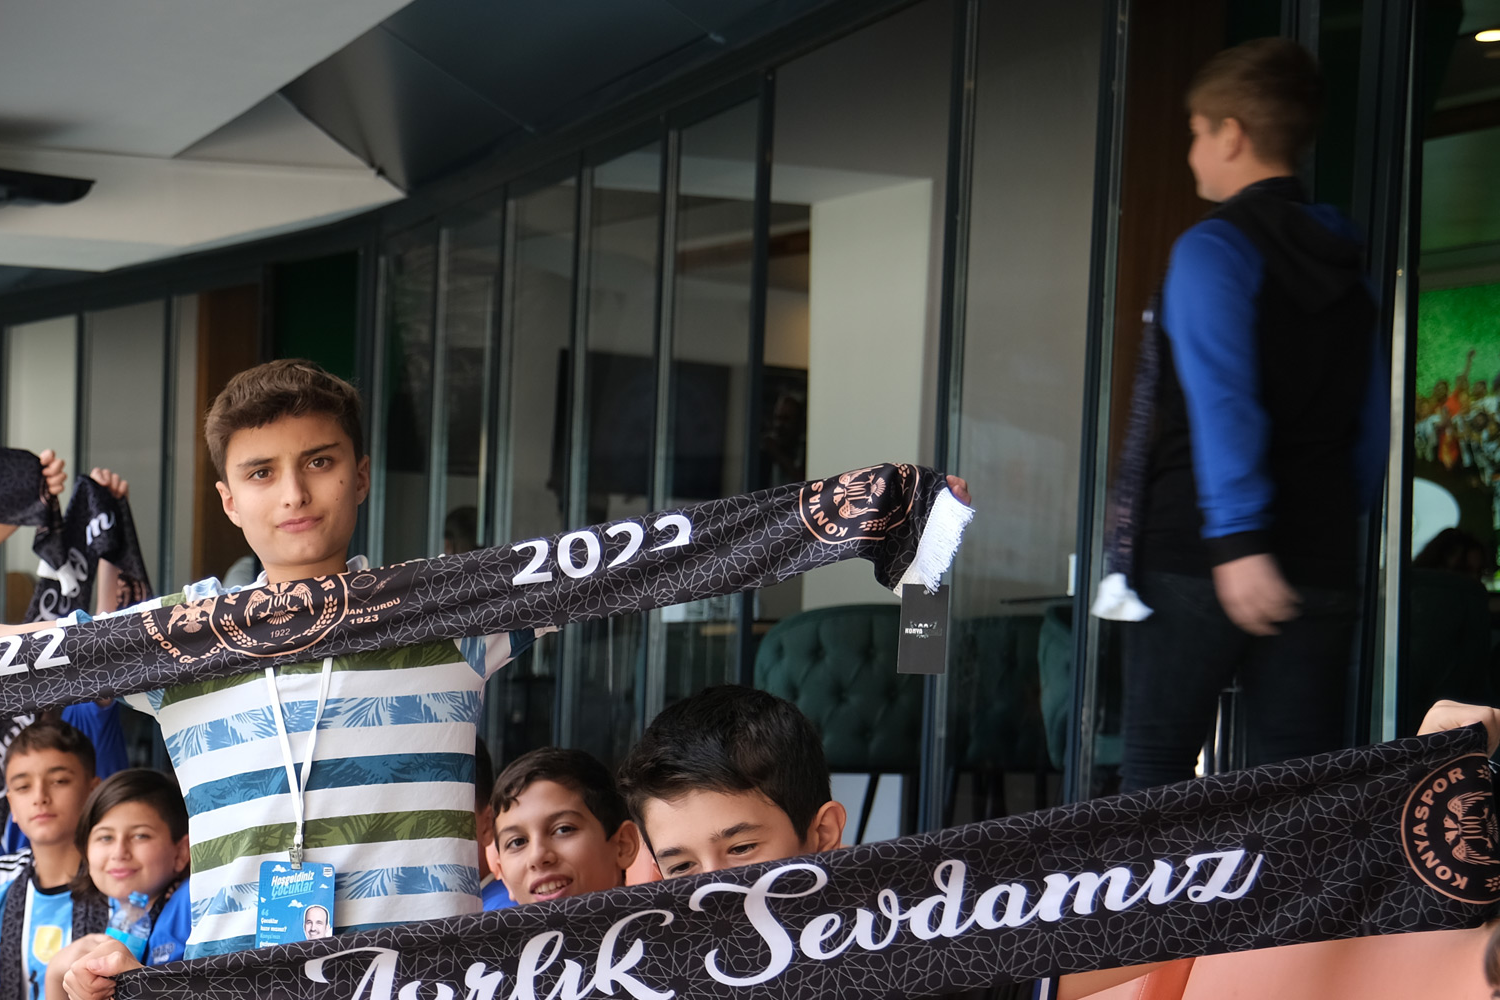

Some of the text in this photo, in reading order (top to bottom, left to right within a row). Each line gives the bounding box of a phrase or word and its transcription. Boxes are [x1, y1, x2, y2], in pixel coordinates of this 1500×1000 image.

[808, 480, 849, 537] KONYAS
[511, 514, 692, 586] 2022
[366, 597, 401, 613] YURDU
[349, 614, 379, 625] 1923
[270, 628, 290, 639] 1922
[1413, 767, 1469, 890] KONYASPOR
[271, 870, 315, 886] Hoşgeldiniz
[271, 881, 315, 898] Çocuklar
[689, 848, 1265, 987] Sevdamız
